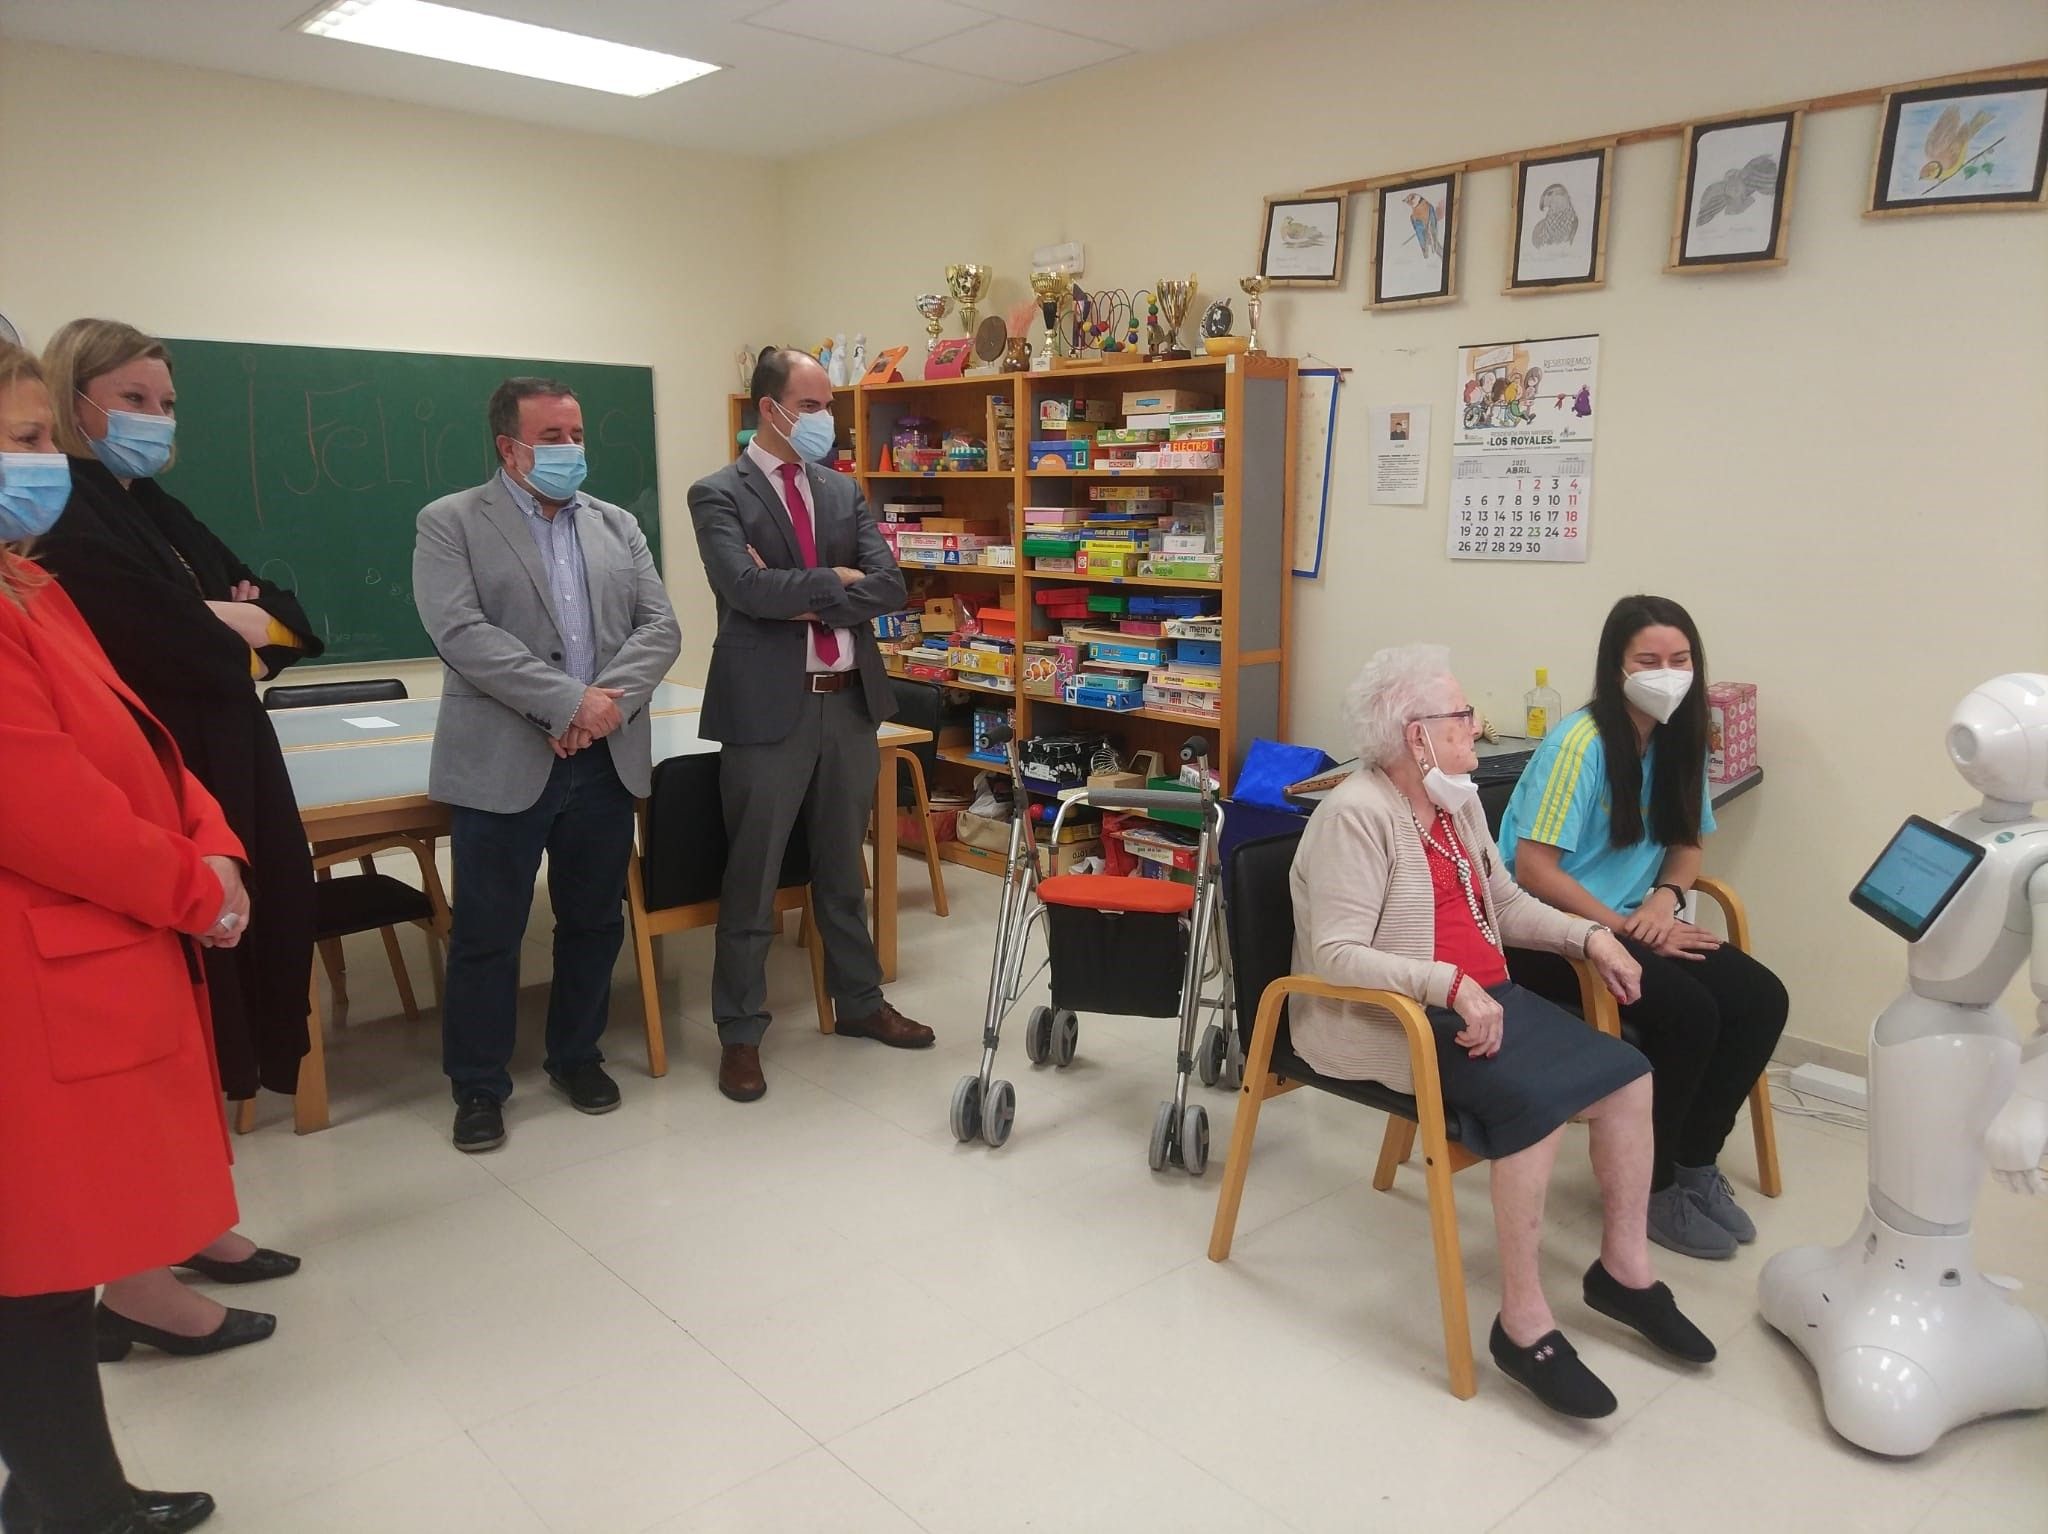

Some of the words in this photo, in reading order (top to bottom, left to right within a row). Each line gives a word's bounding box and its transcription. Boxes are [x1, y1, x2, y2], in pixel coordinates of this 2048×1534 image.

[1172, 441, 1209, 452] ELECTRO
[1517, 480, 1521, 489] 1
[1534, 479, 1540, 489] 2
[1552, 479, 1559, 489] 3
[1570, 479, 1578, 489] 4
[1464, 496, 1471, 505] 5
[1481, 496, 1487, 505] 6
[1498, 496, 1504, 505] 7
[1515, 496, 1522, 505] 8
[1533, 495, 1539, 505] 9
[1548, 495, 1560, 505] 10
[1568, 495, 1577, 505] 11
[1461, 511, 1471, 521] 12
[1478, 511, 1488, 521] 13
[1495, 511, 1505, 521] 14
[1512, 511, 1522, 521] 15
[1530, 511, 1541, 521] 16
[1547, 511, 1559, 521] 17
[1566, 511, 1577, 521] 18
[1460, 526, 1470, 536] 19
[1475, 527, 1488, 536] 20
[1494, 527, 1504, 536] 21
[1510, 527, 1523, 536] 22
[1528, 527, 1541, 537] 23
[1545, 527, 1559, 537] 24
[1564, 527, 1577, 537] 25
[1458, 542, 1471, 551] 26
[1475, 542, 1488, 552] 27
[1492, 542, 1505, 552] 28
[1509, 542, 1522, 552] 29
[1526, 543, 1540, 552] 30
[1189, 625, 1212, 634] memo
